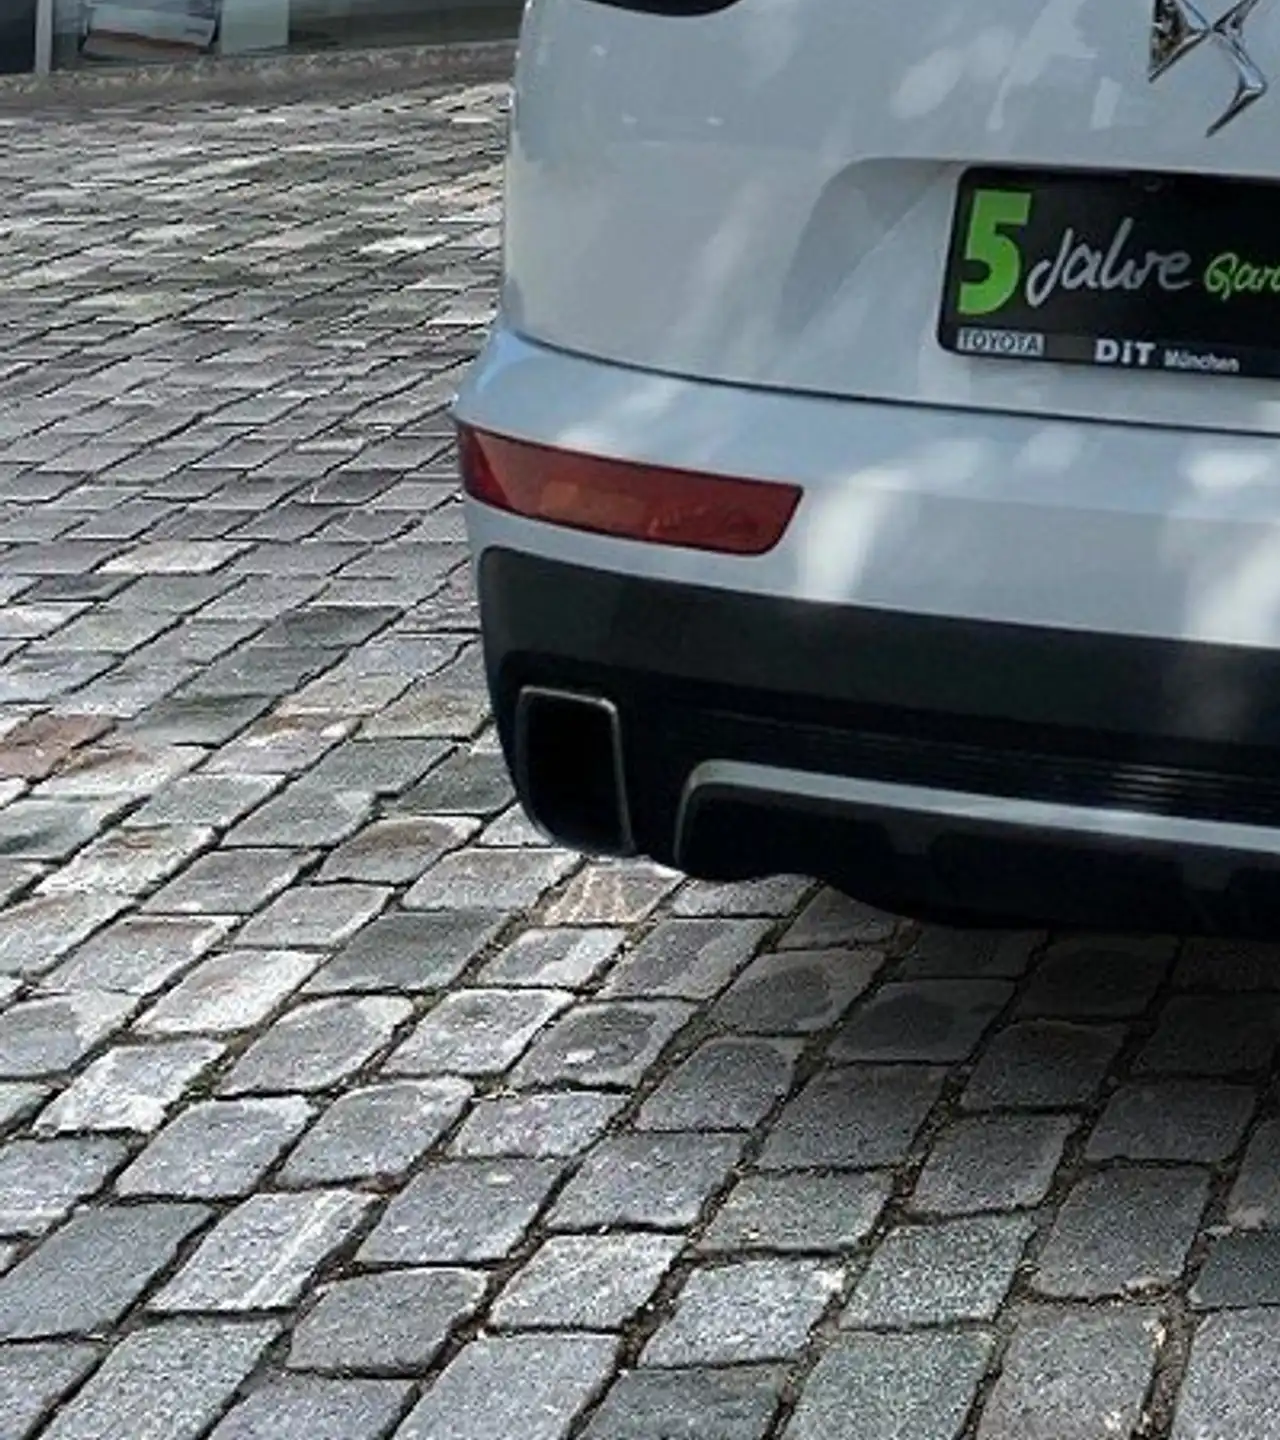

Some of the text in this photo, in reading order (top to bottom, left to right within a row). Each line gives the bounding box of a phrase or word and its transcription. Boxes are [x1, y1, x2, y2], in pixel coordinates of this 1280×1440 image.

[957, 189, 1033, 317] 5
[1026, 216, 1193, 309] Jahre
[961, 330, 1041, 355] TOYOTA
[1163, 348, 1240, 373] München
